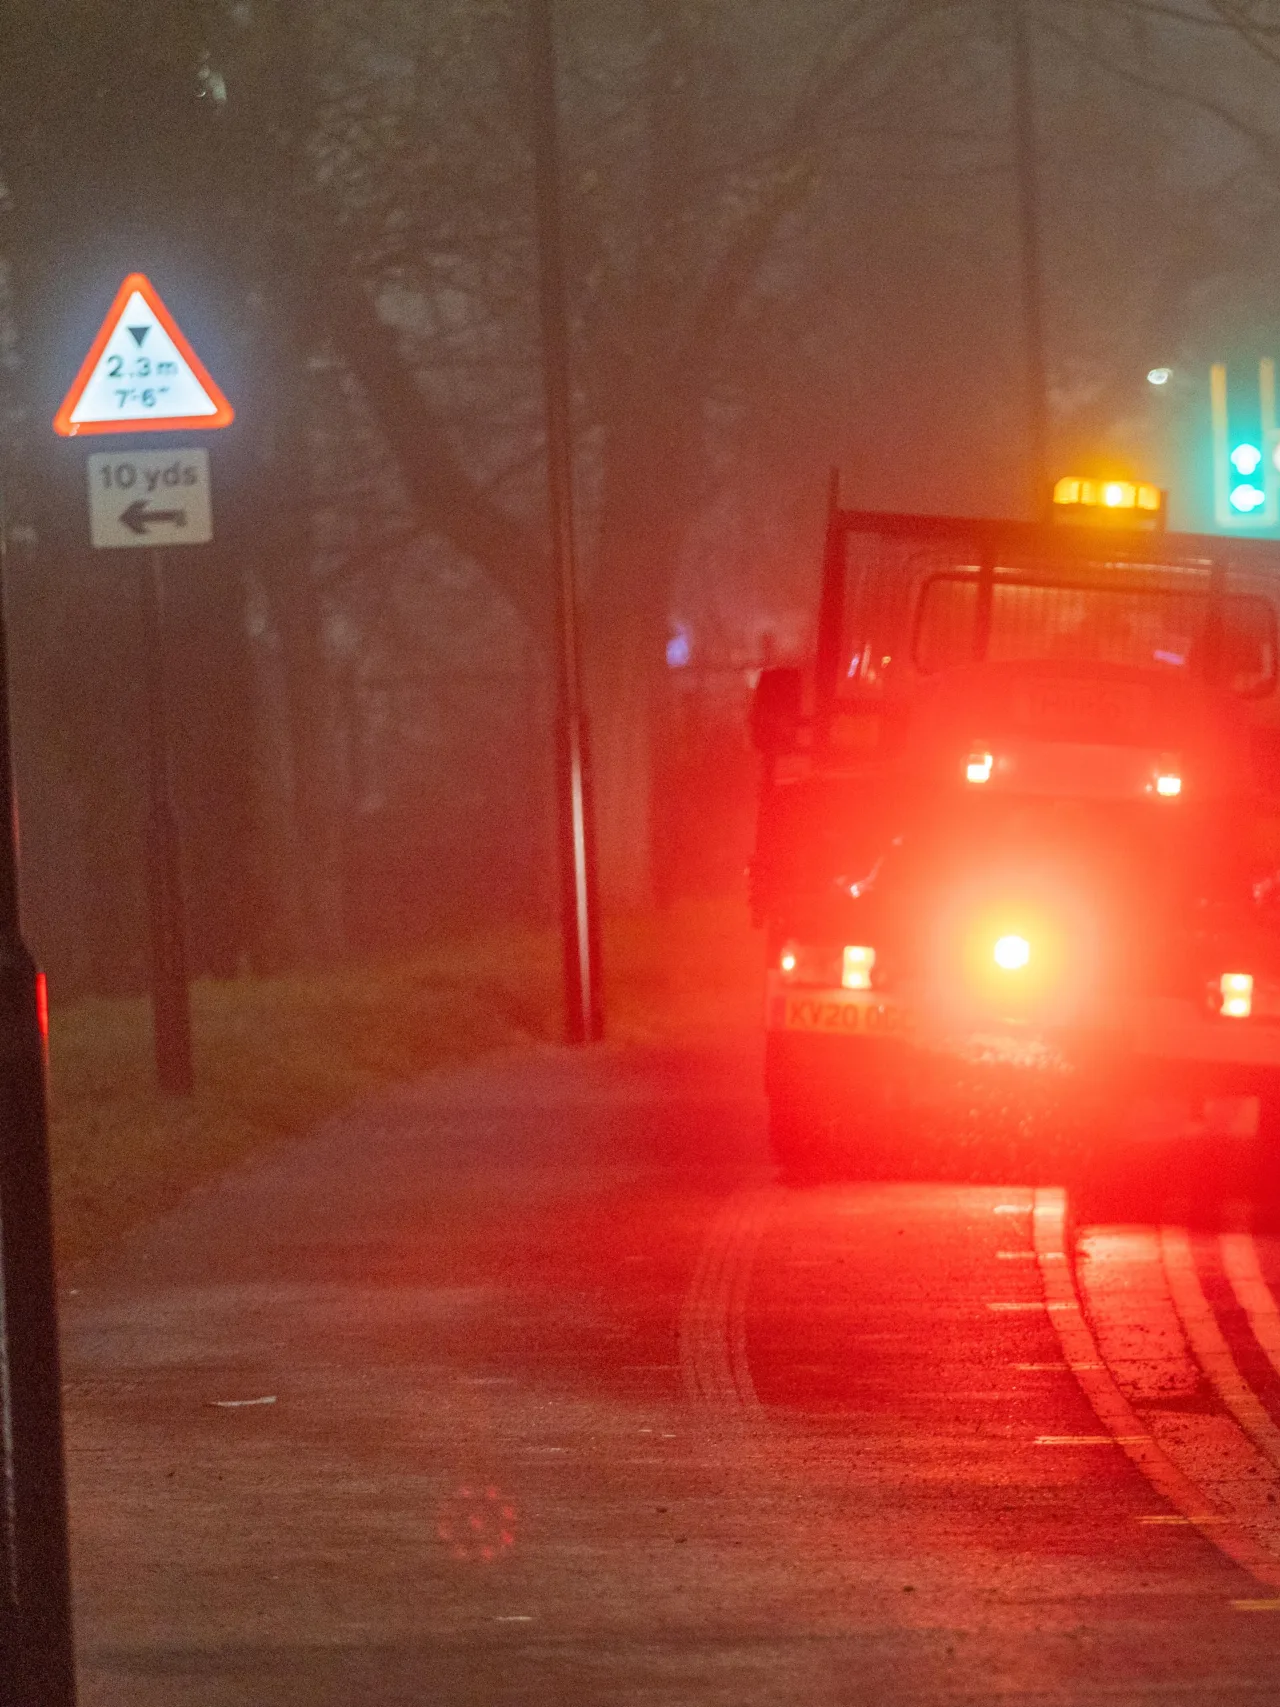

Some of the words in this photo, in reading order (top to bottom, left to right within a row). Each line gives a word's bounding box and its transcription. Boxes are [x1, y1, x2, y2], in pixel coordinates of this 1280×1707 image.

[107, 355, 150, 378] 2.3
[101, 463, 136, 489] 10
[144, 461, 198, 492] yds
[790, 1000, 859, 1029] KV20
